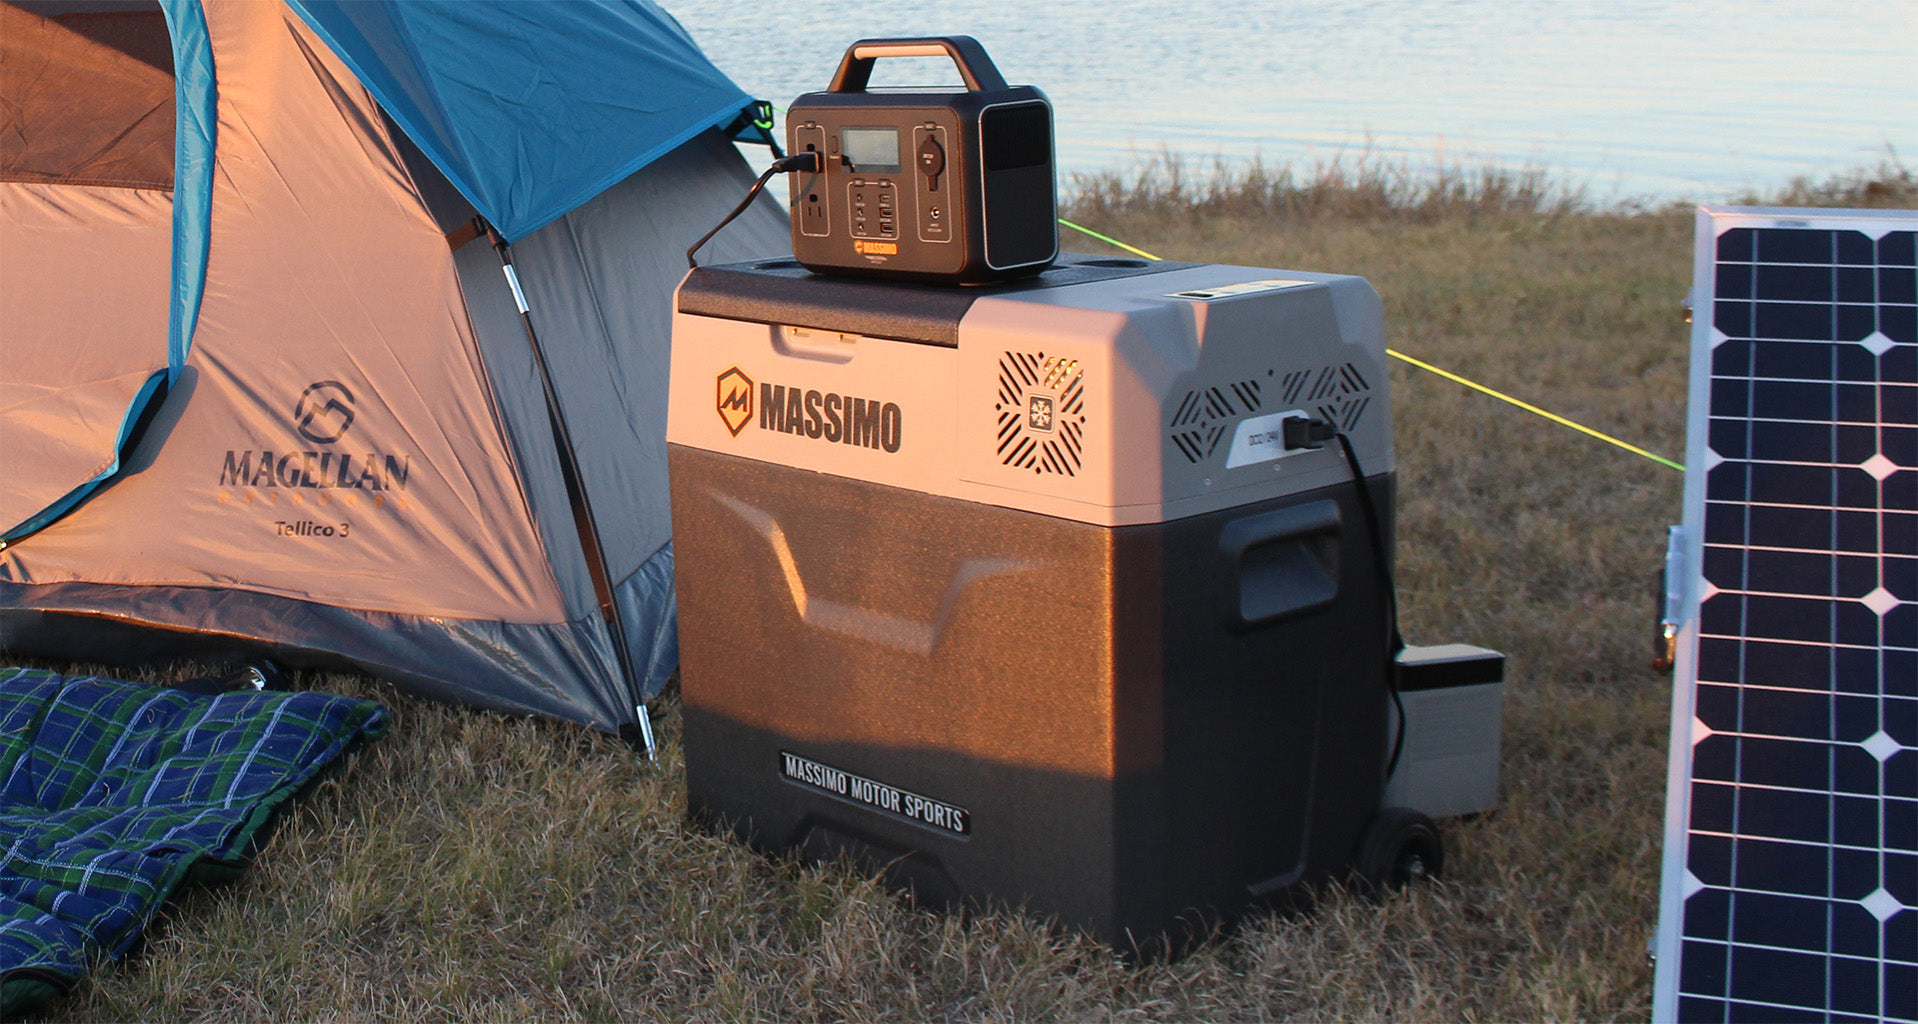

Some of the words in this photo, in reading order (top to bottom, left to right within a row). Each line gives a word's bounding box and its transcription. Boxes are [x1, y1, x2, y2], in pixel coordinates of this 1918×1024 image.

[759, 382, 902, 453] MASSIMO
[219, 450, 410, 492] MAGELLAN
[217, 491, 409, 511] OUTDOORS
[275, 521, 335, 537] Tellico
[339, 523, 350, 537] 3
[785, 756, 847, 795] MASSIMO
[851, 778, 901, 813] MOTOR
[904, 795, 963, 833] SPORTS
